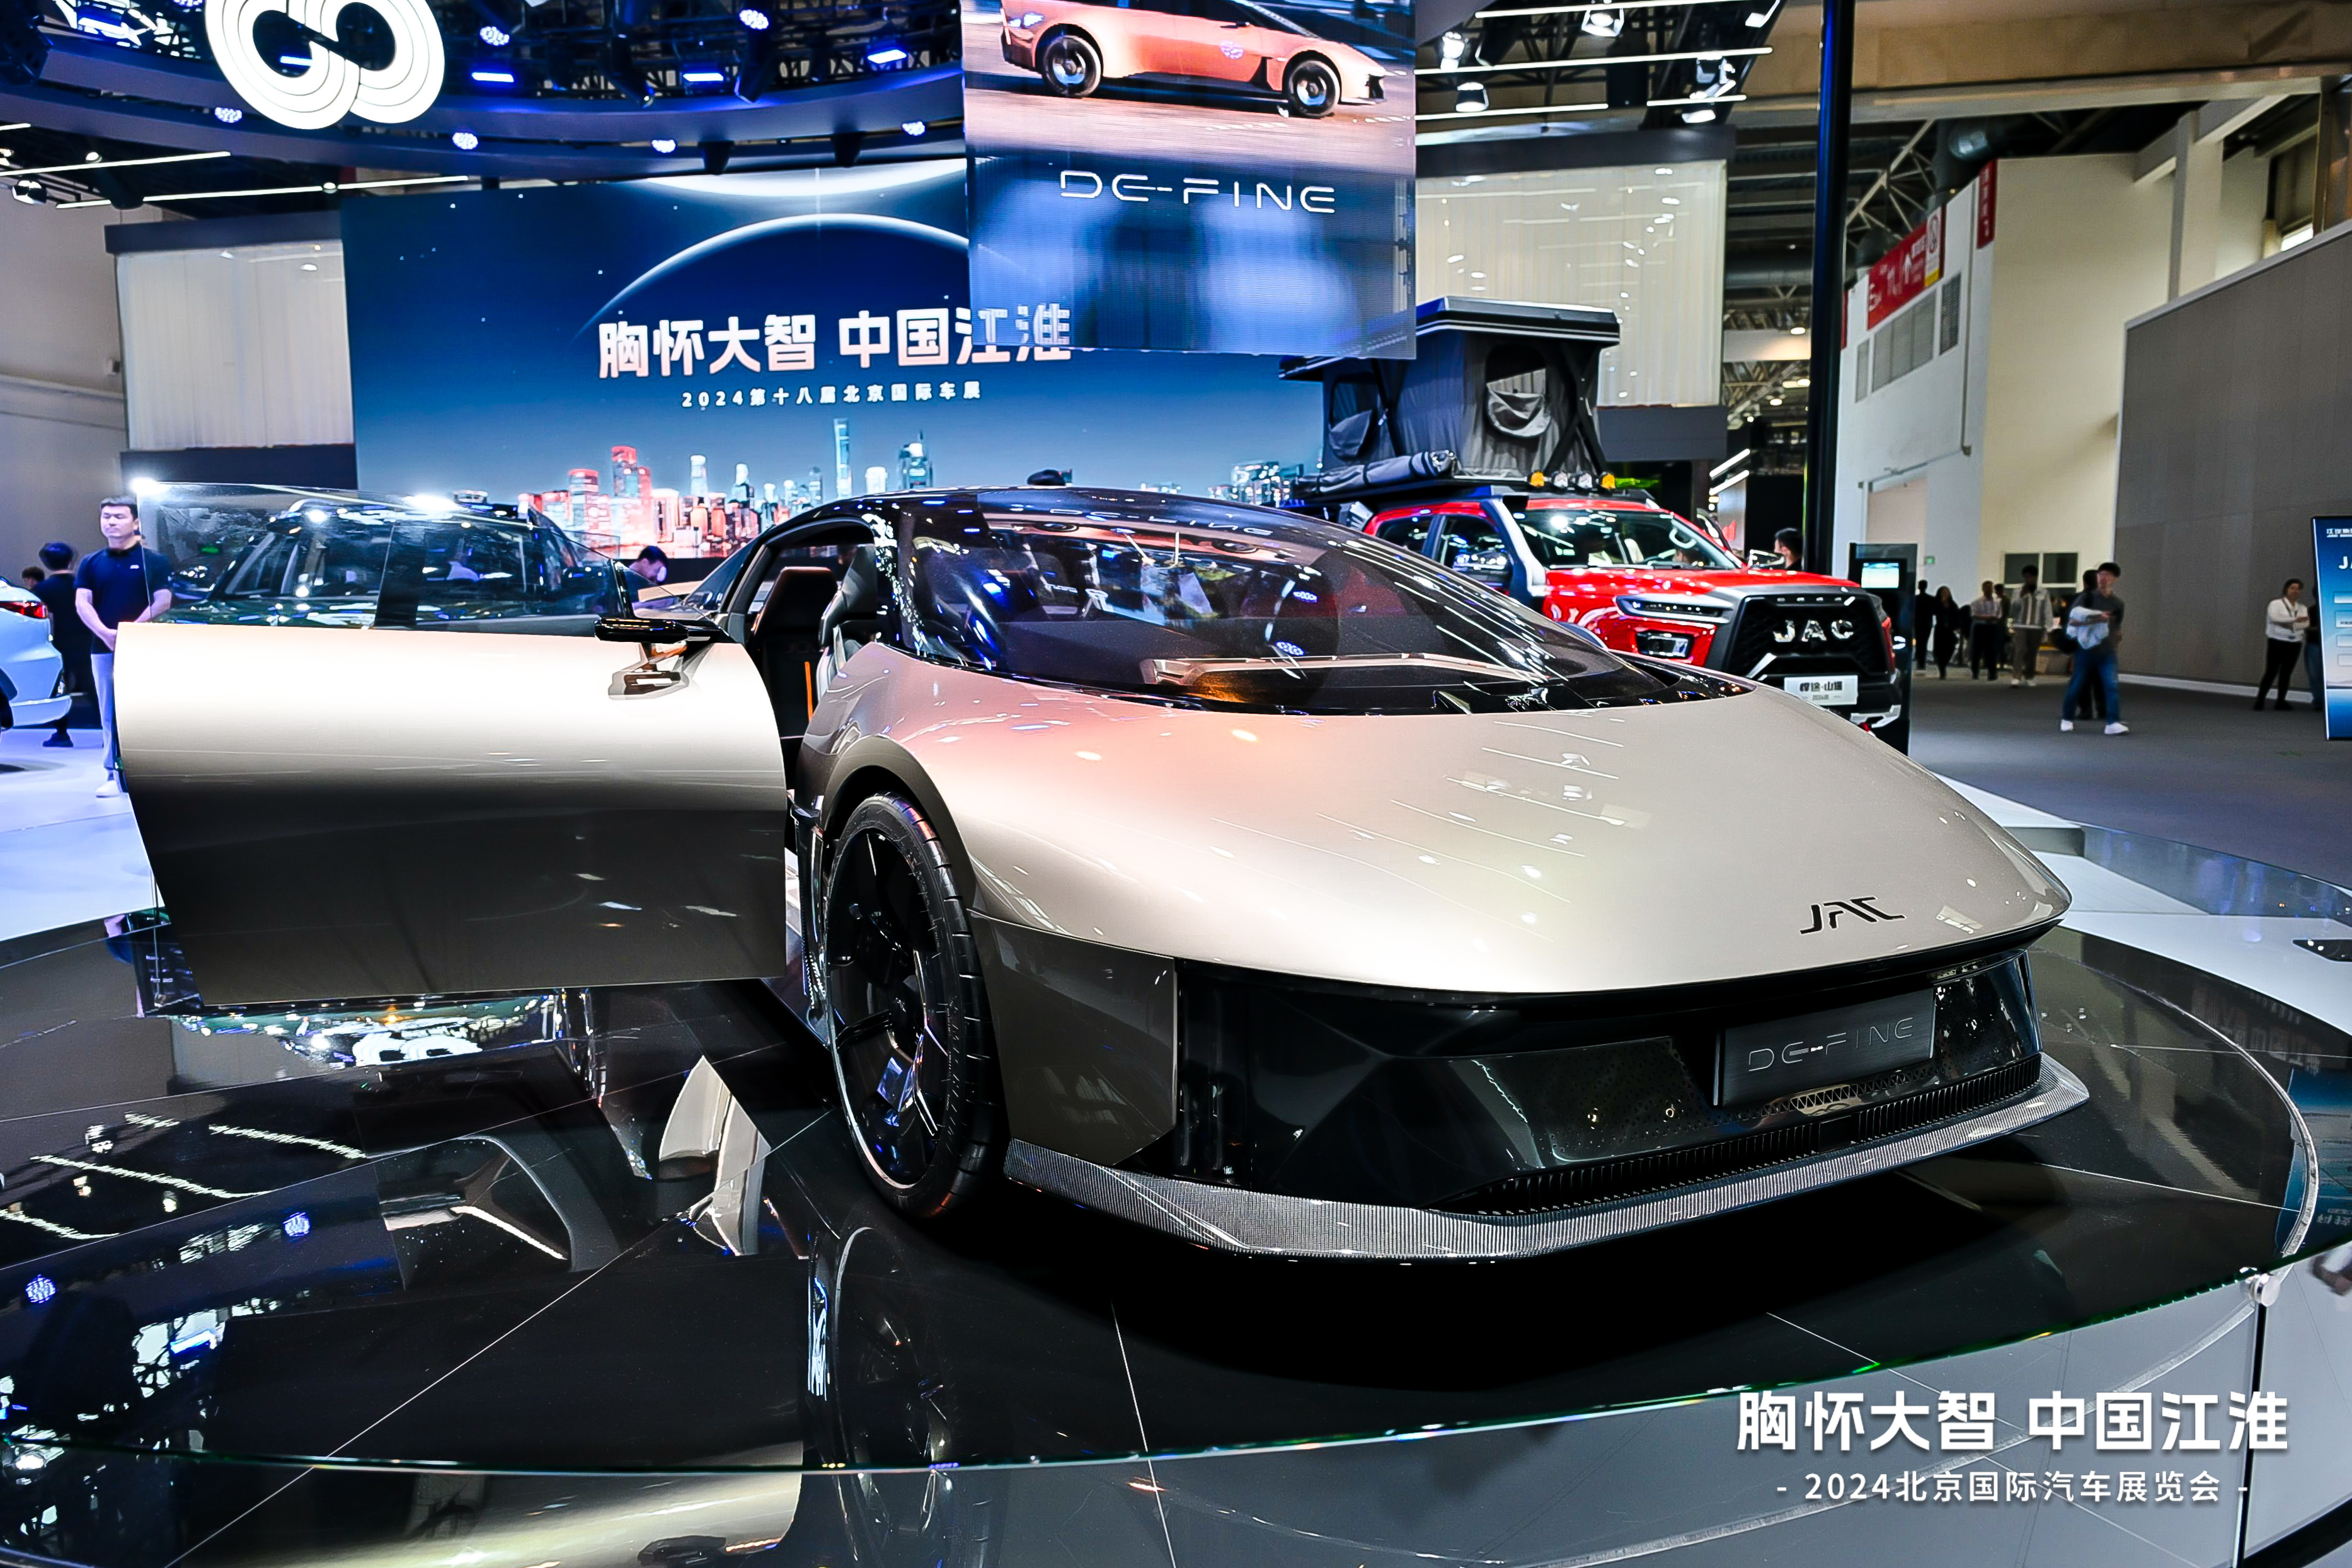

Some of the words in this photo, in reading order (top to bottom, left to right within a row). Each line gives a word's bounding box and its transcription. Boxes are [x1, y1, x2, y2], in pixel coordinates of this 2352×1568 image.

[1060, 170, 1335, 213] DE-FINE
[599, 314, 816, 378] 胸怀大智
[839, 302, 1071, 368] 中国江淮
[682, 381, 980, 407] 2024第十八届北京国际车展
[2338, 556, 2352, 569] J
[1773, 619, 1854, 642] JAC
[1799, 896, 1906, 934] JAC
[1748, 1017, 1913, 1071] DE-FINE
